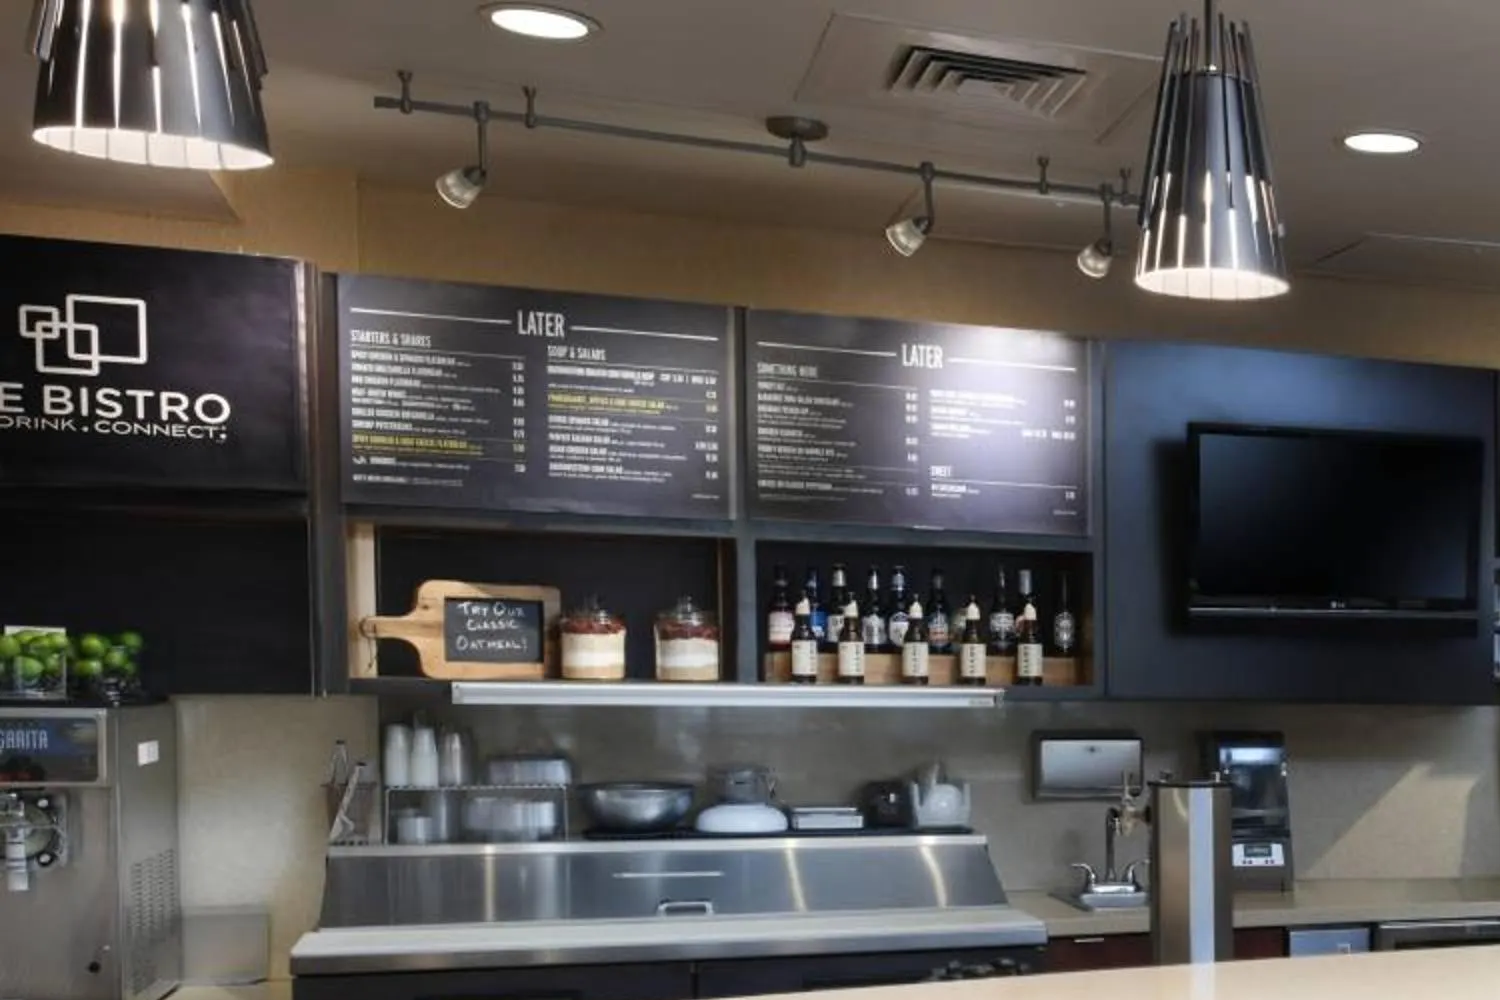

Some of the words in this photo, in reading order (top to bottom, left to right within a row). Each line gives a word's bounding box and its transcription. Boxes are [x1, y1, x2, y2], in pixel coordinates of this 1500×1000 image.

[517, 309, 566, 339] LATER
[901, 343, 943, 369] LATER
[42, 384, 231, 424] BISTRO
